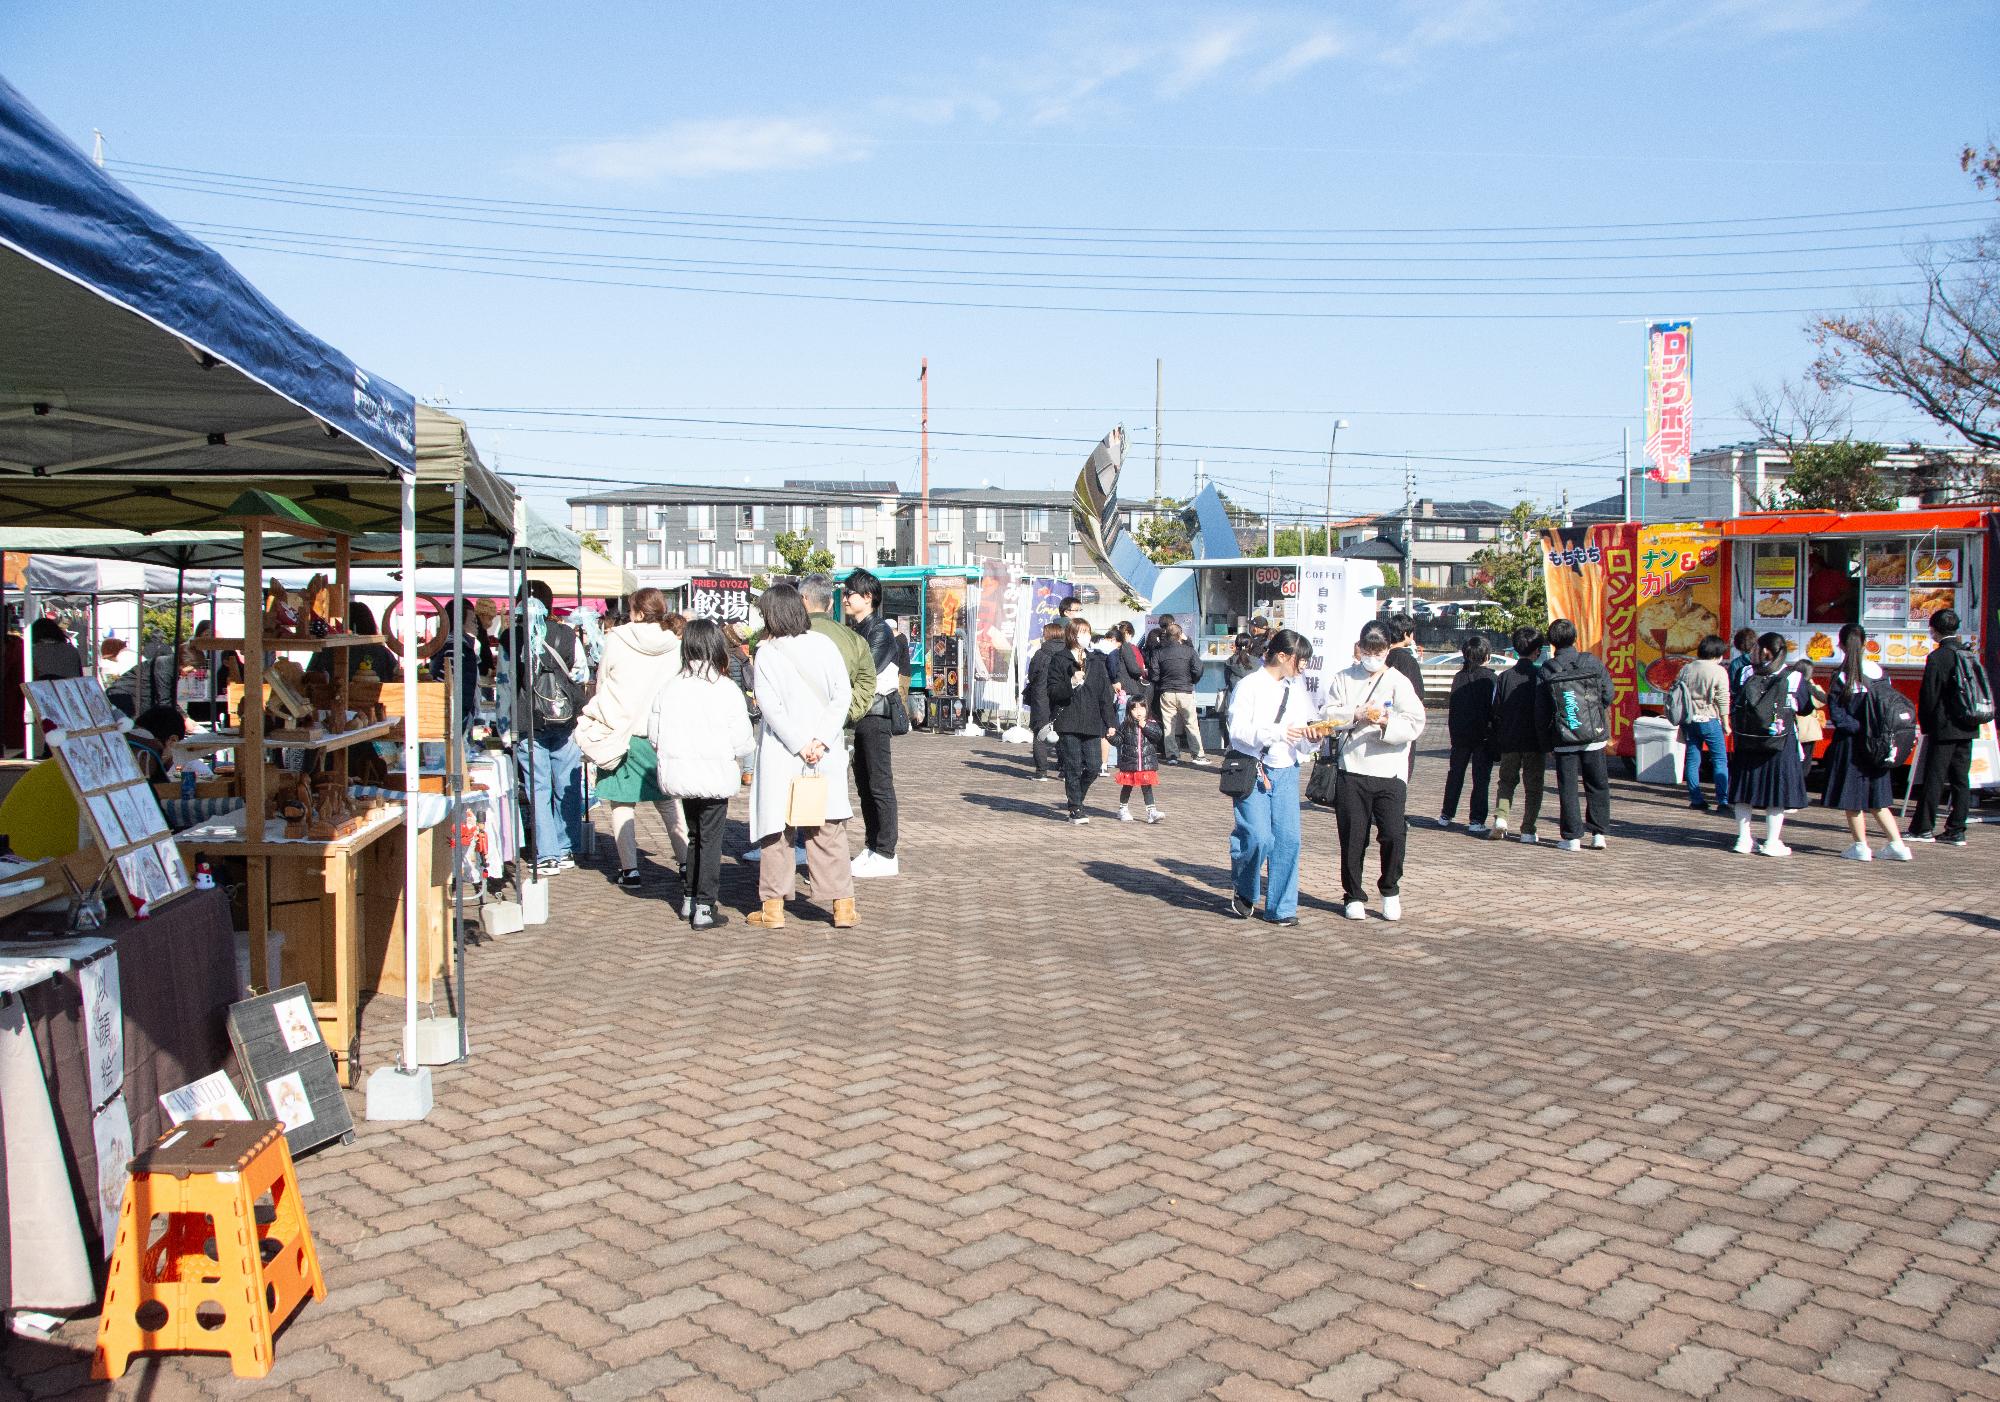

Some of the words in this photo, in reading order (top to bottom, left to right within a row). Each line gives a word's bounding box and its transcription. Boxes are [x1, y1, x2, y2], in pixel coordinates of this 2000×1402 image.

[1662, 332, 1687, 479] ロングポテト
[1548, 546, 1601, 567] もちもち
[693, 579, 718, 588] FRIED
[719, 579, 749, 589] GYOZA
[1258, 569, 1279, 583] 500
[1640, 571, 1710, 598] カレー
[1604, 548, 1637, 736] ロングポテト
[166, 1079, 227, 1113] WANTED
